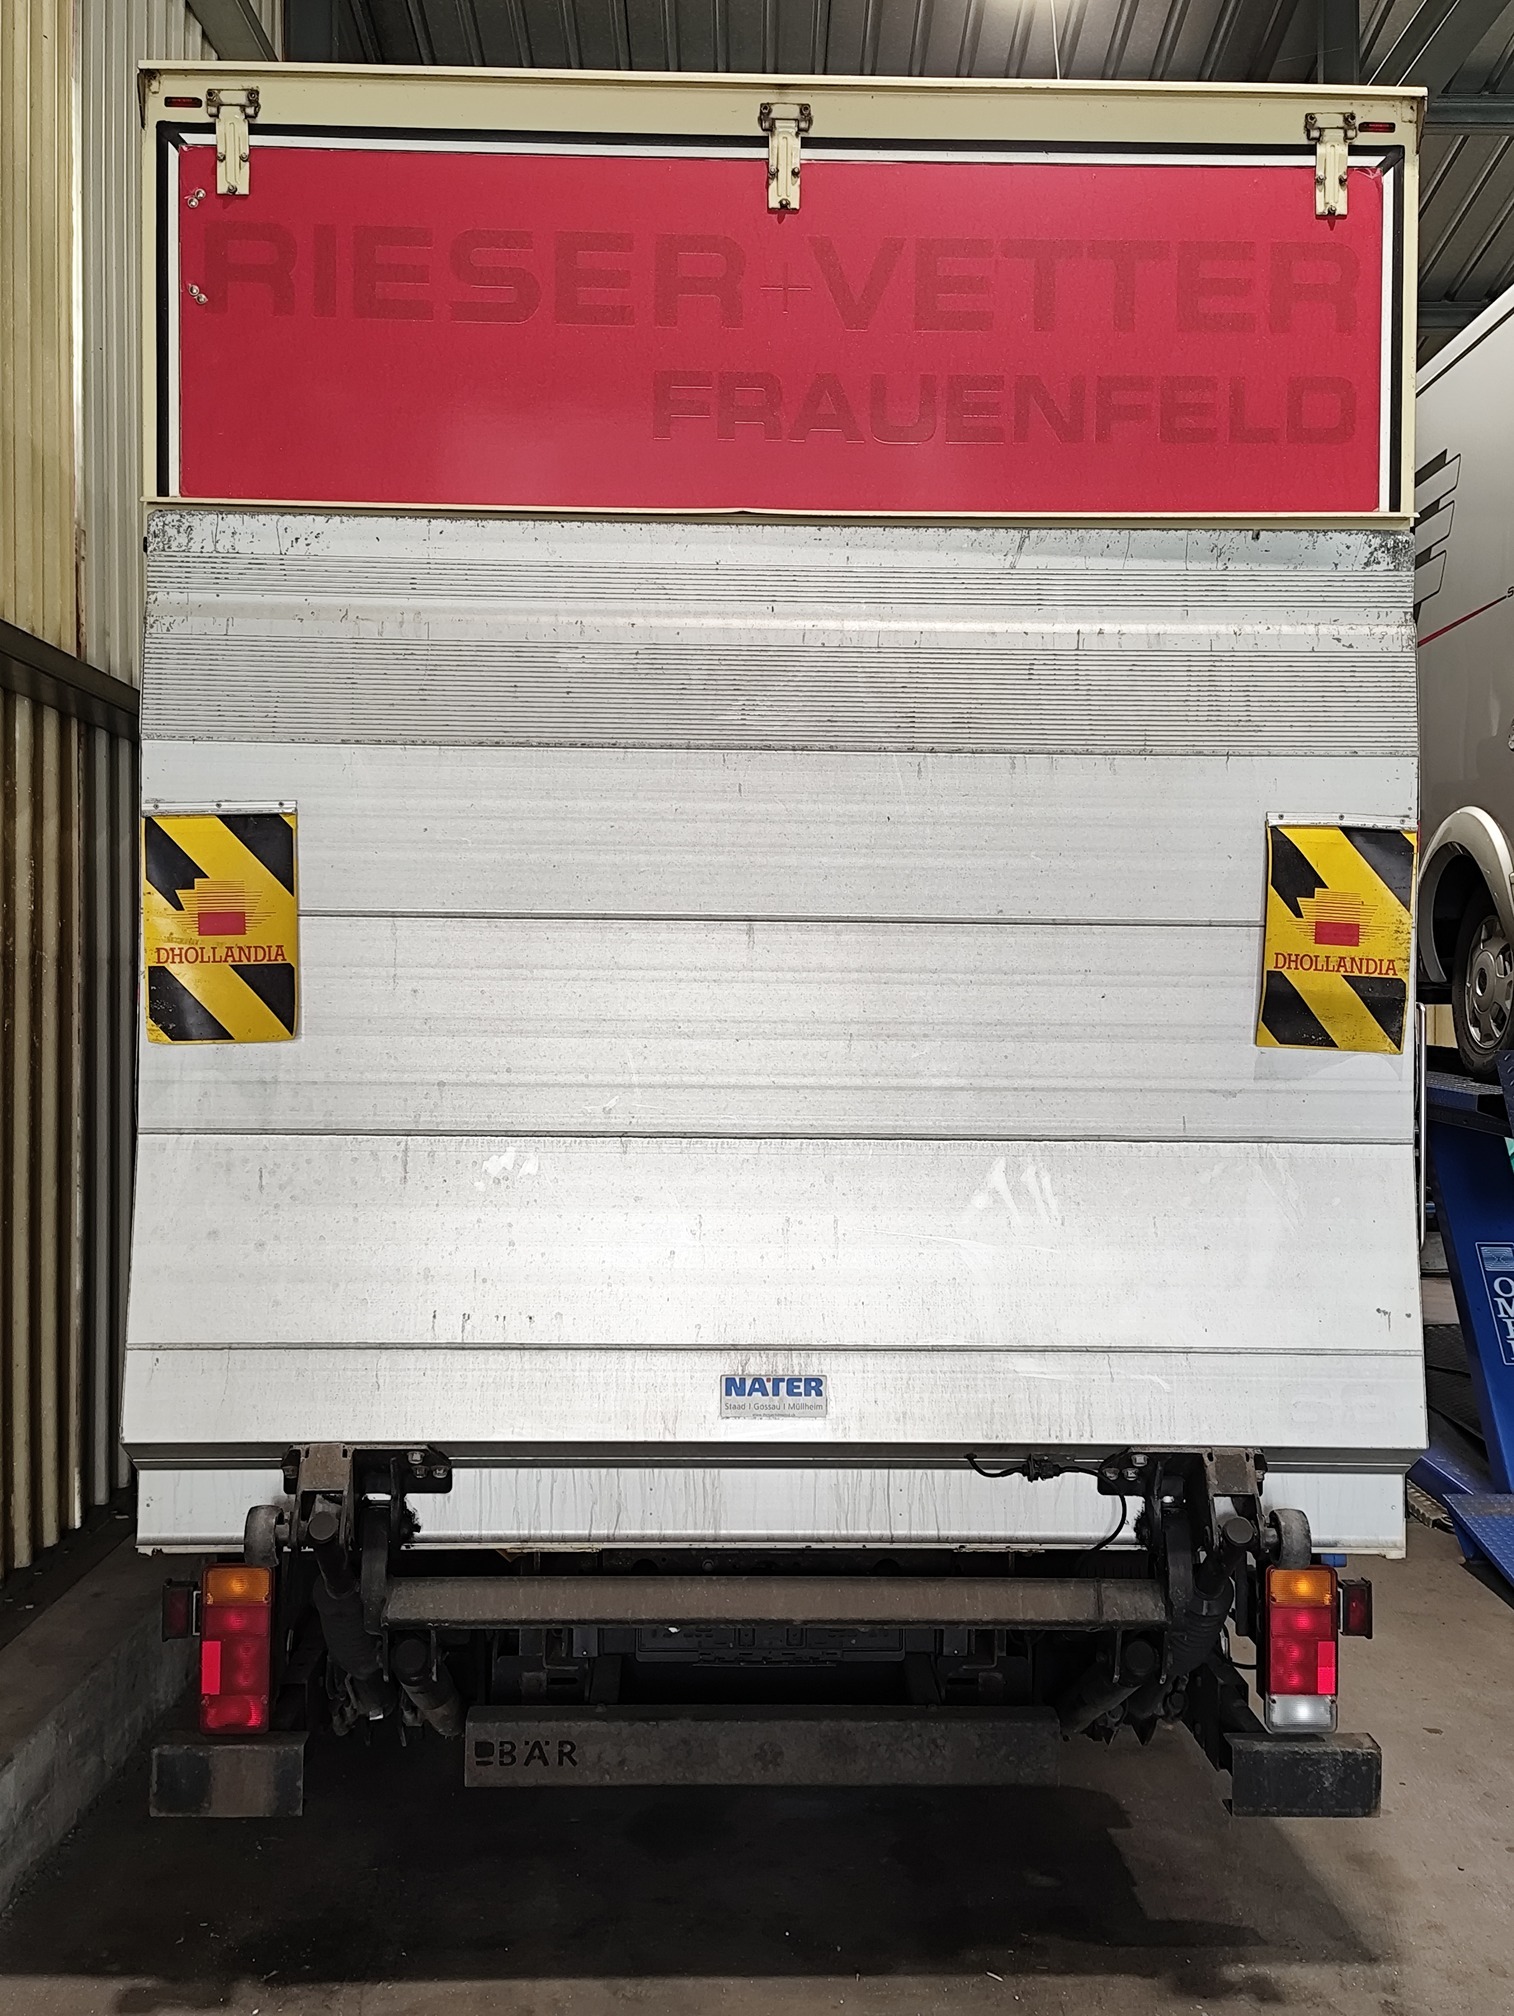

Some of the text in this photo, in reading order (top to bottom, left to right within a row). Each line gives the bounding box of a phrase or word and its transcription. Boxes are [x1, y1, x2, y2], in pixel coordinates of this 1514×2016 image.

[652, 369, 1357, 446] FRAUENFELD
[155, 945, 287, 965] DHOLLANDIA
[1273, 952, 1399, 976] DHOLLANDIA
[725, 1377, 824, 1397] NATER
[724, 1402, 746, 1411] Staad
[753, 1402, 781, 1411] Gossau
[788, 1402, 824, 1411] Müllheim
[498, 1740, 578, 1767] BÄR
